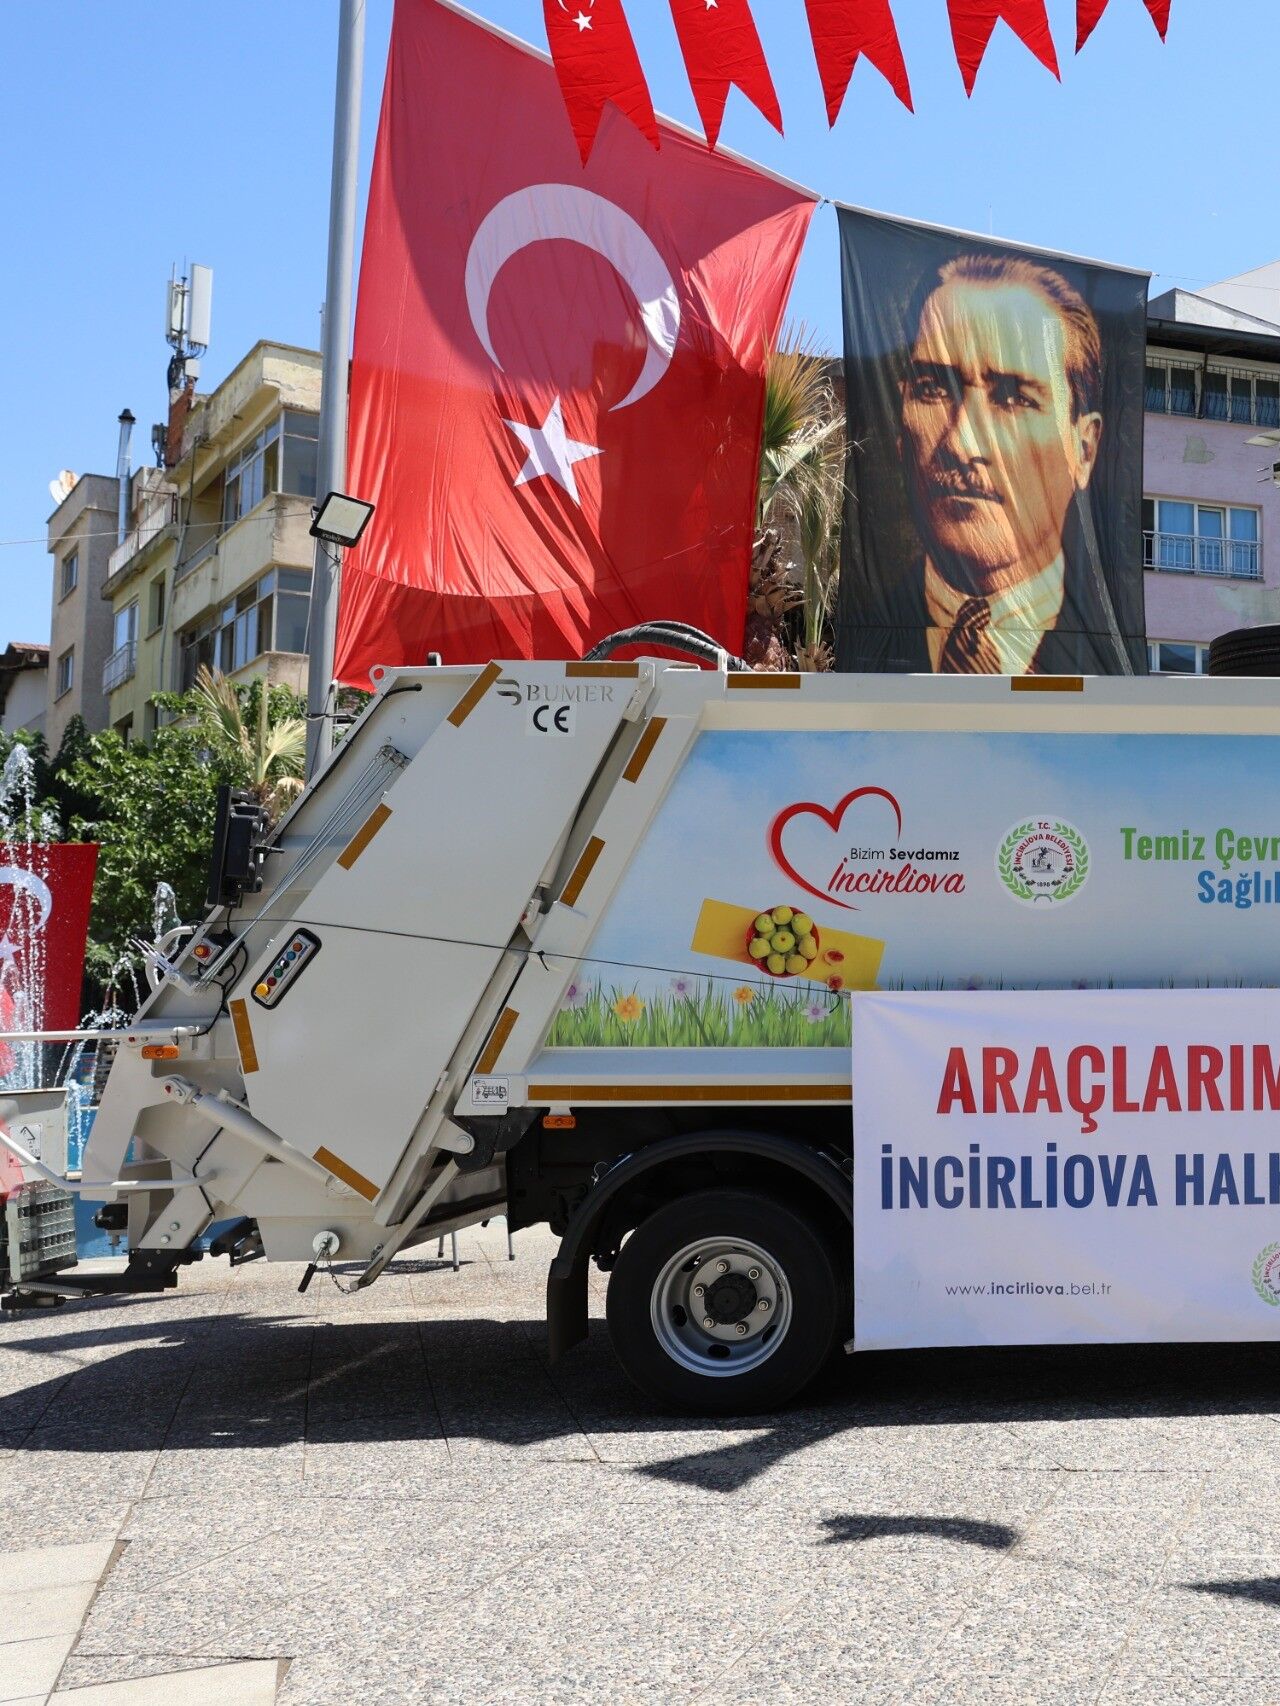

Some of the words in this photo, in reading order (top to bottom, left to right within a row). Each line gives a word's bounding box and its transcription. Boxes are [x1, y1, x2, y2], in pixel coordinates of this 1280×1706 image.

[526, 684, 614, 702] BUMER
[533, 704, 570, 733] CE
[1037, 822, 1051, 830] T.C.
[850, 848, 885, 860] Bizim
[889, 848, 960, 861] Sevdamız
[1014, 834, 1044, 865] İNCİRLİOVA
[1045, 834, 1074, 866] BELEDİYESİ
[1120, 828, 1205, 861] Temiz
[828, 857, 965, 893] İncirliova
[881, 1143, 1159, 1210] İNCİRLİOVA
[945, 1282, 1111, 1296] www.incirliova.bel.tr
